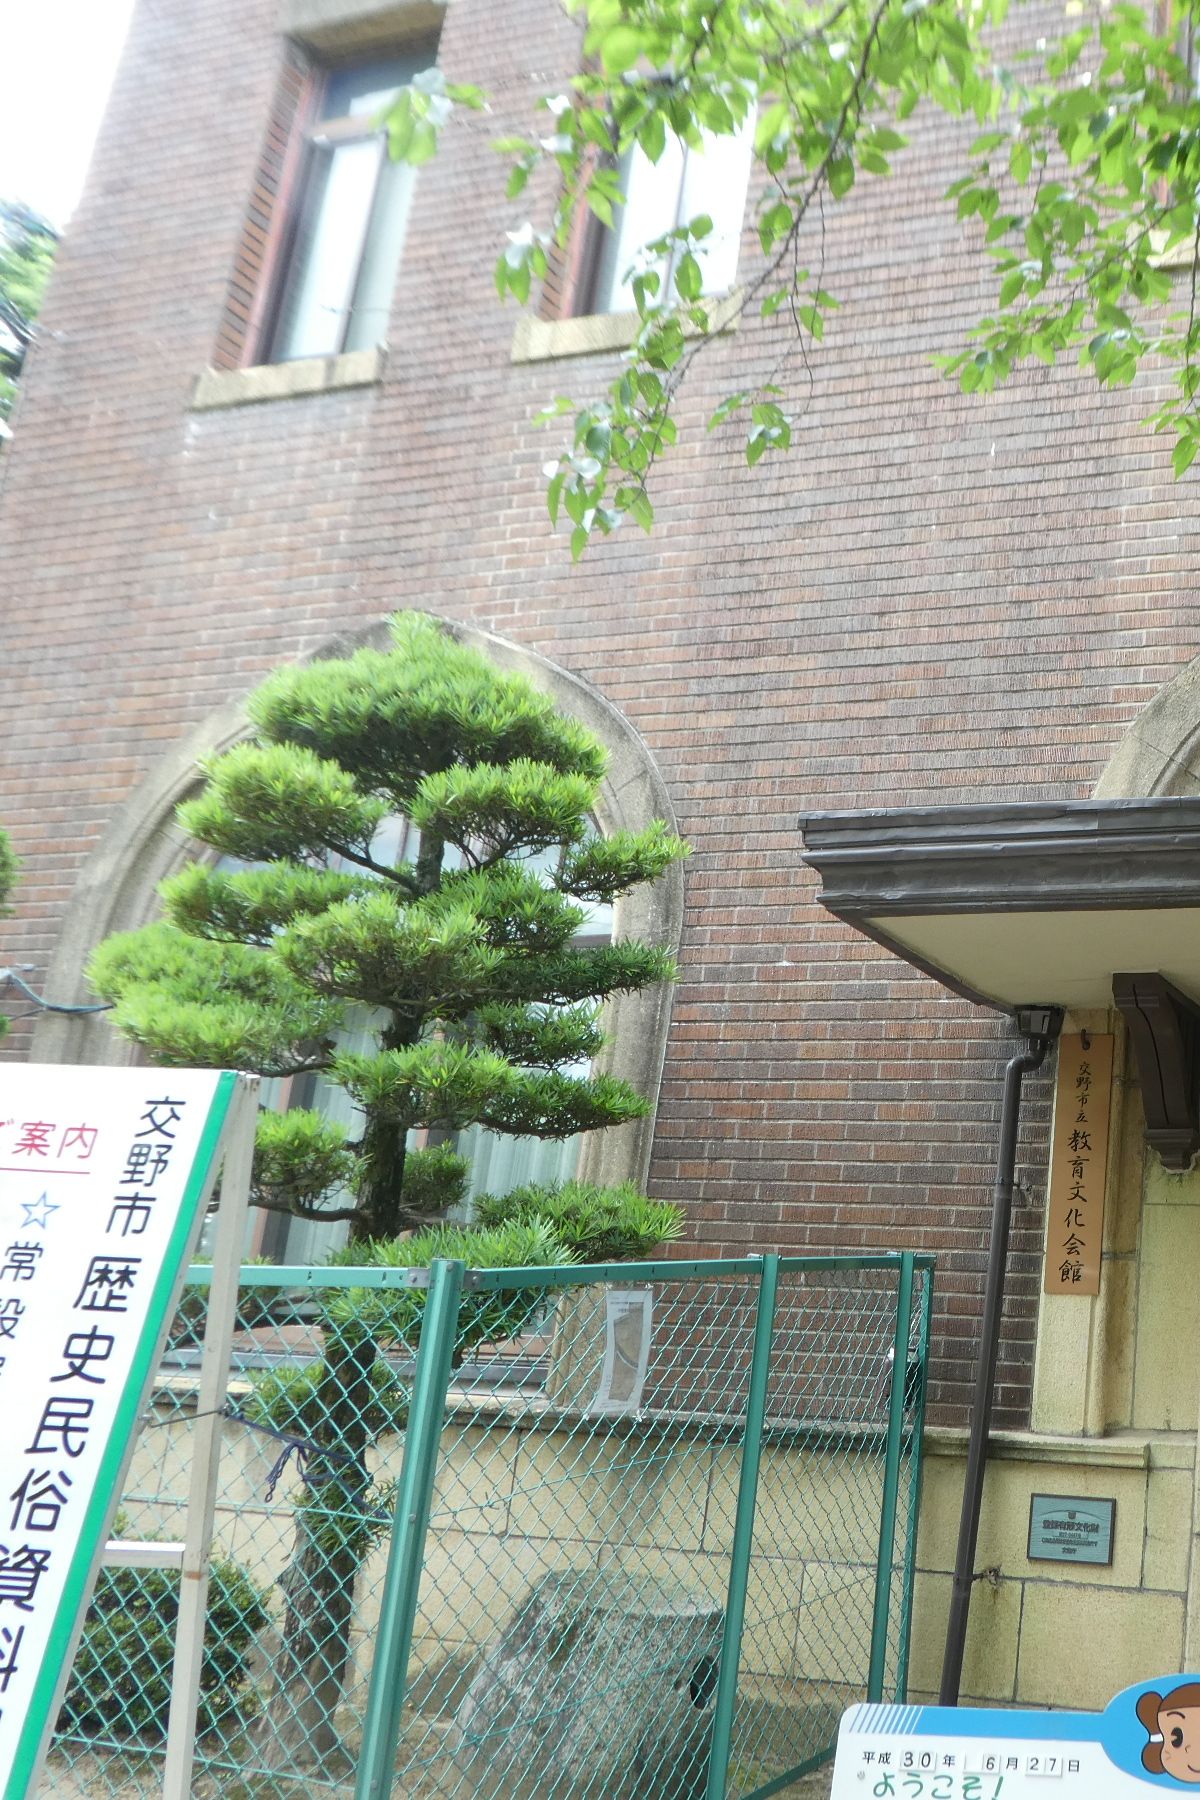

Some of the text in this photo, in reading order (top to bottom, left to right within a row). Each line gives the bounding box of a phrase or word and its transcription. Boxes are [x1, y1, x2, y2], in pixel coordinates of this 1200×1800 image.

[1058, 1061, 1092, 1284] 交野市立教育文化会館
